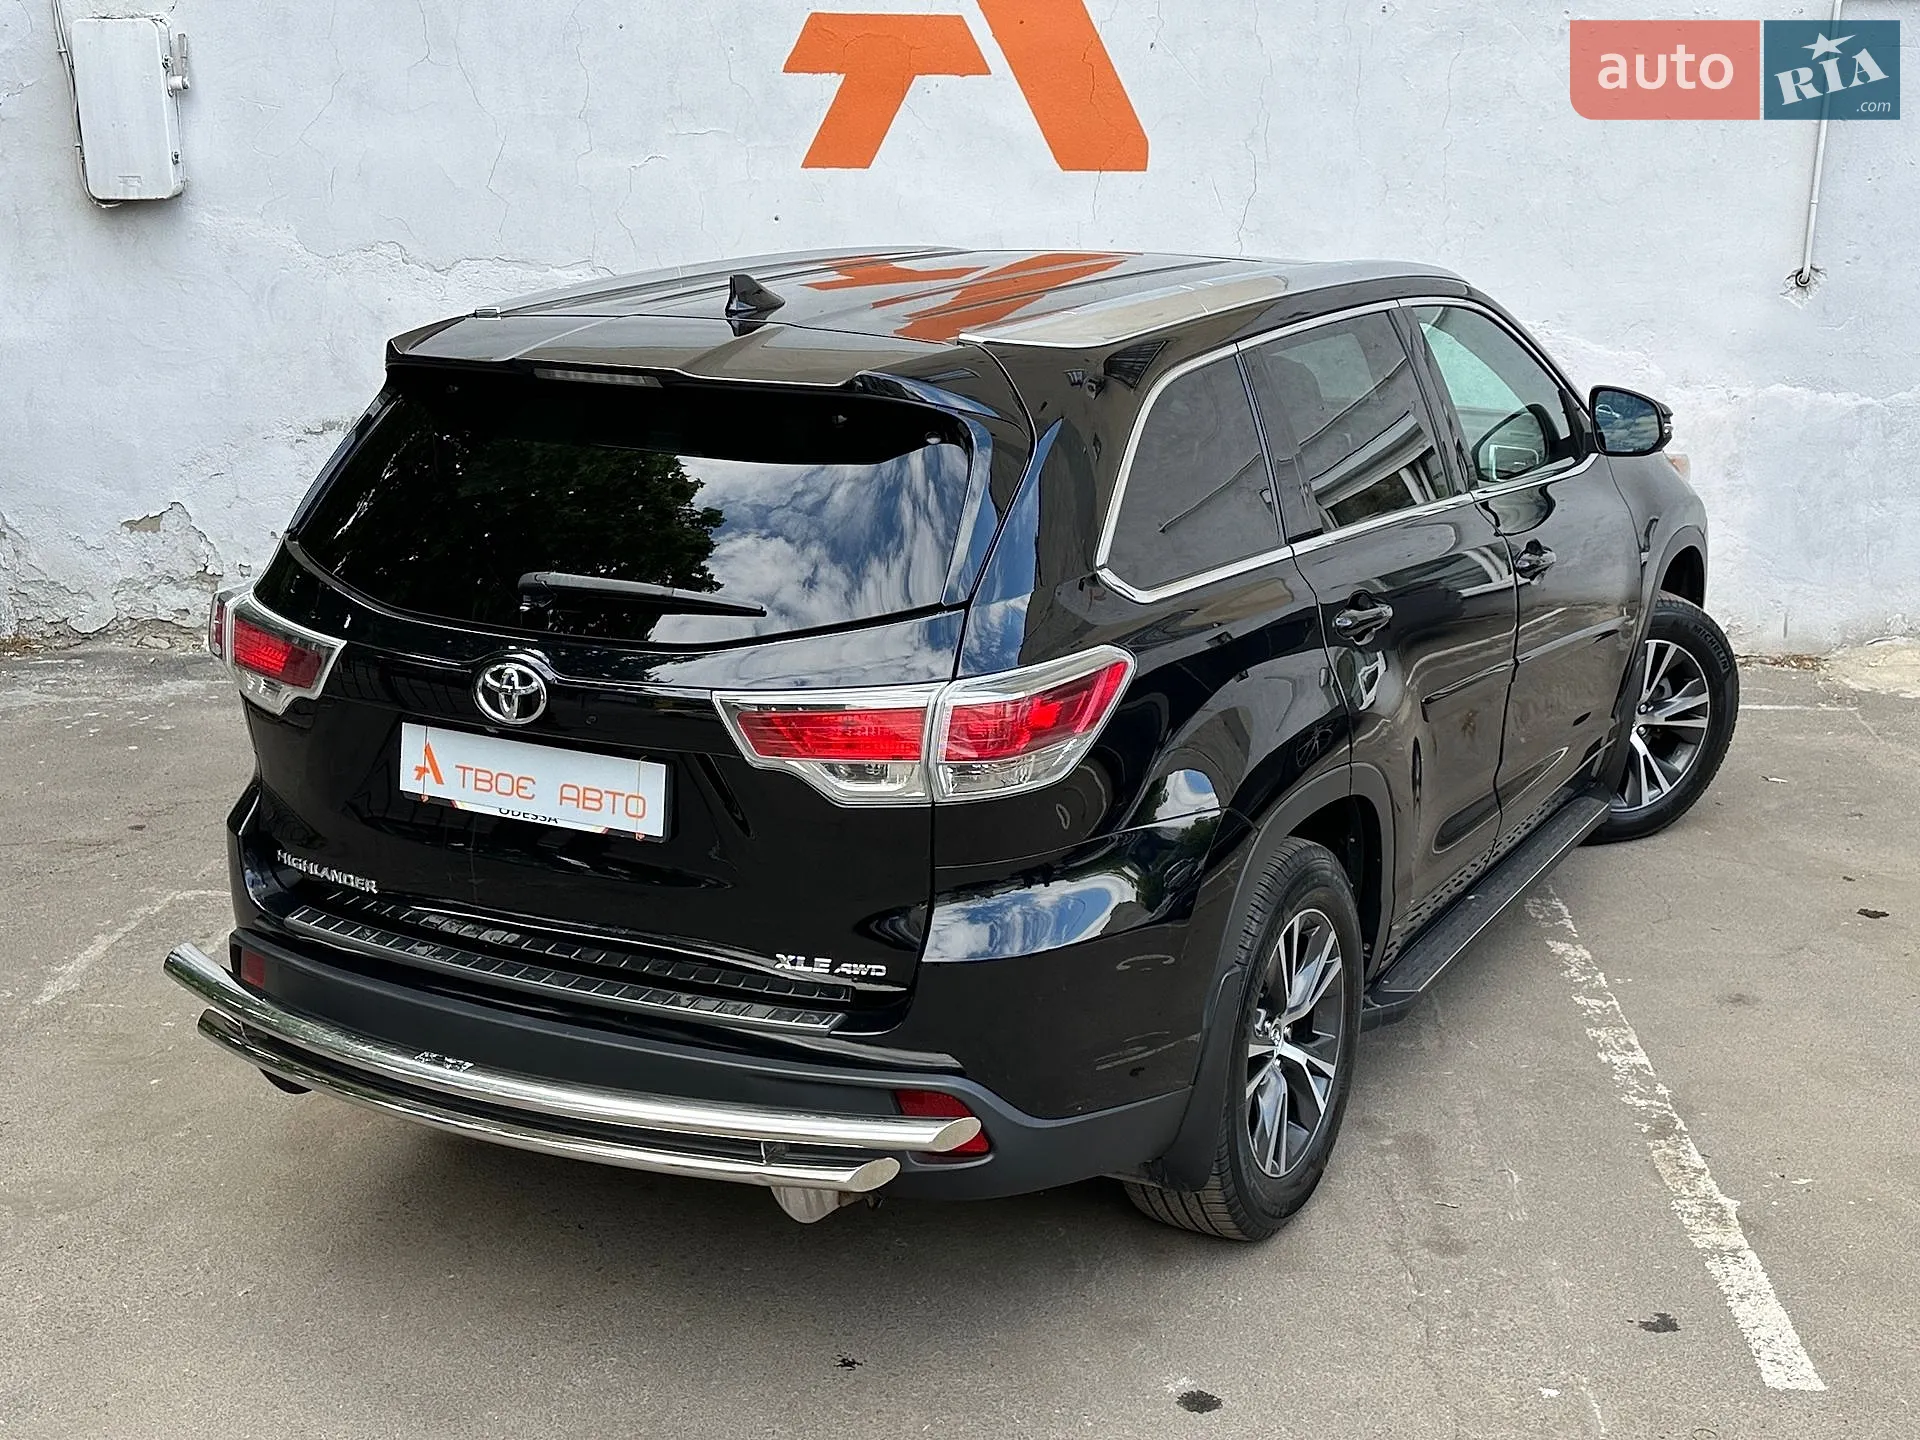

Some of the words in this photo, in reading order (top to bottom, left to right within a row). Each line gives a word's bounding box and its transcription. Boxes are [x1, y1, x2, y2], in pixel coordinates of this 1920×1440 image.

[1692, 624, 1731, 674] MICHELIN
[559, 784, 646, 820] АВТО
[276, 849, 378, 894] HIGHLANDER
[774, 953, 832, 973] XLE
[833, 963, 887, 976] AWD
